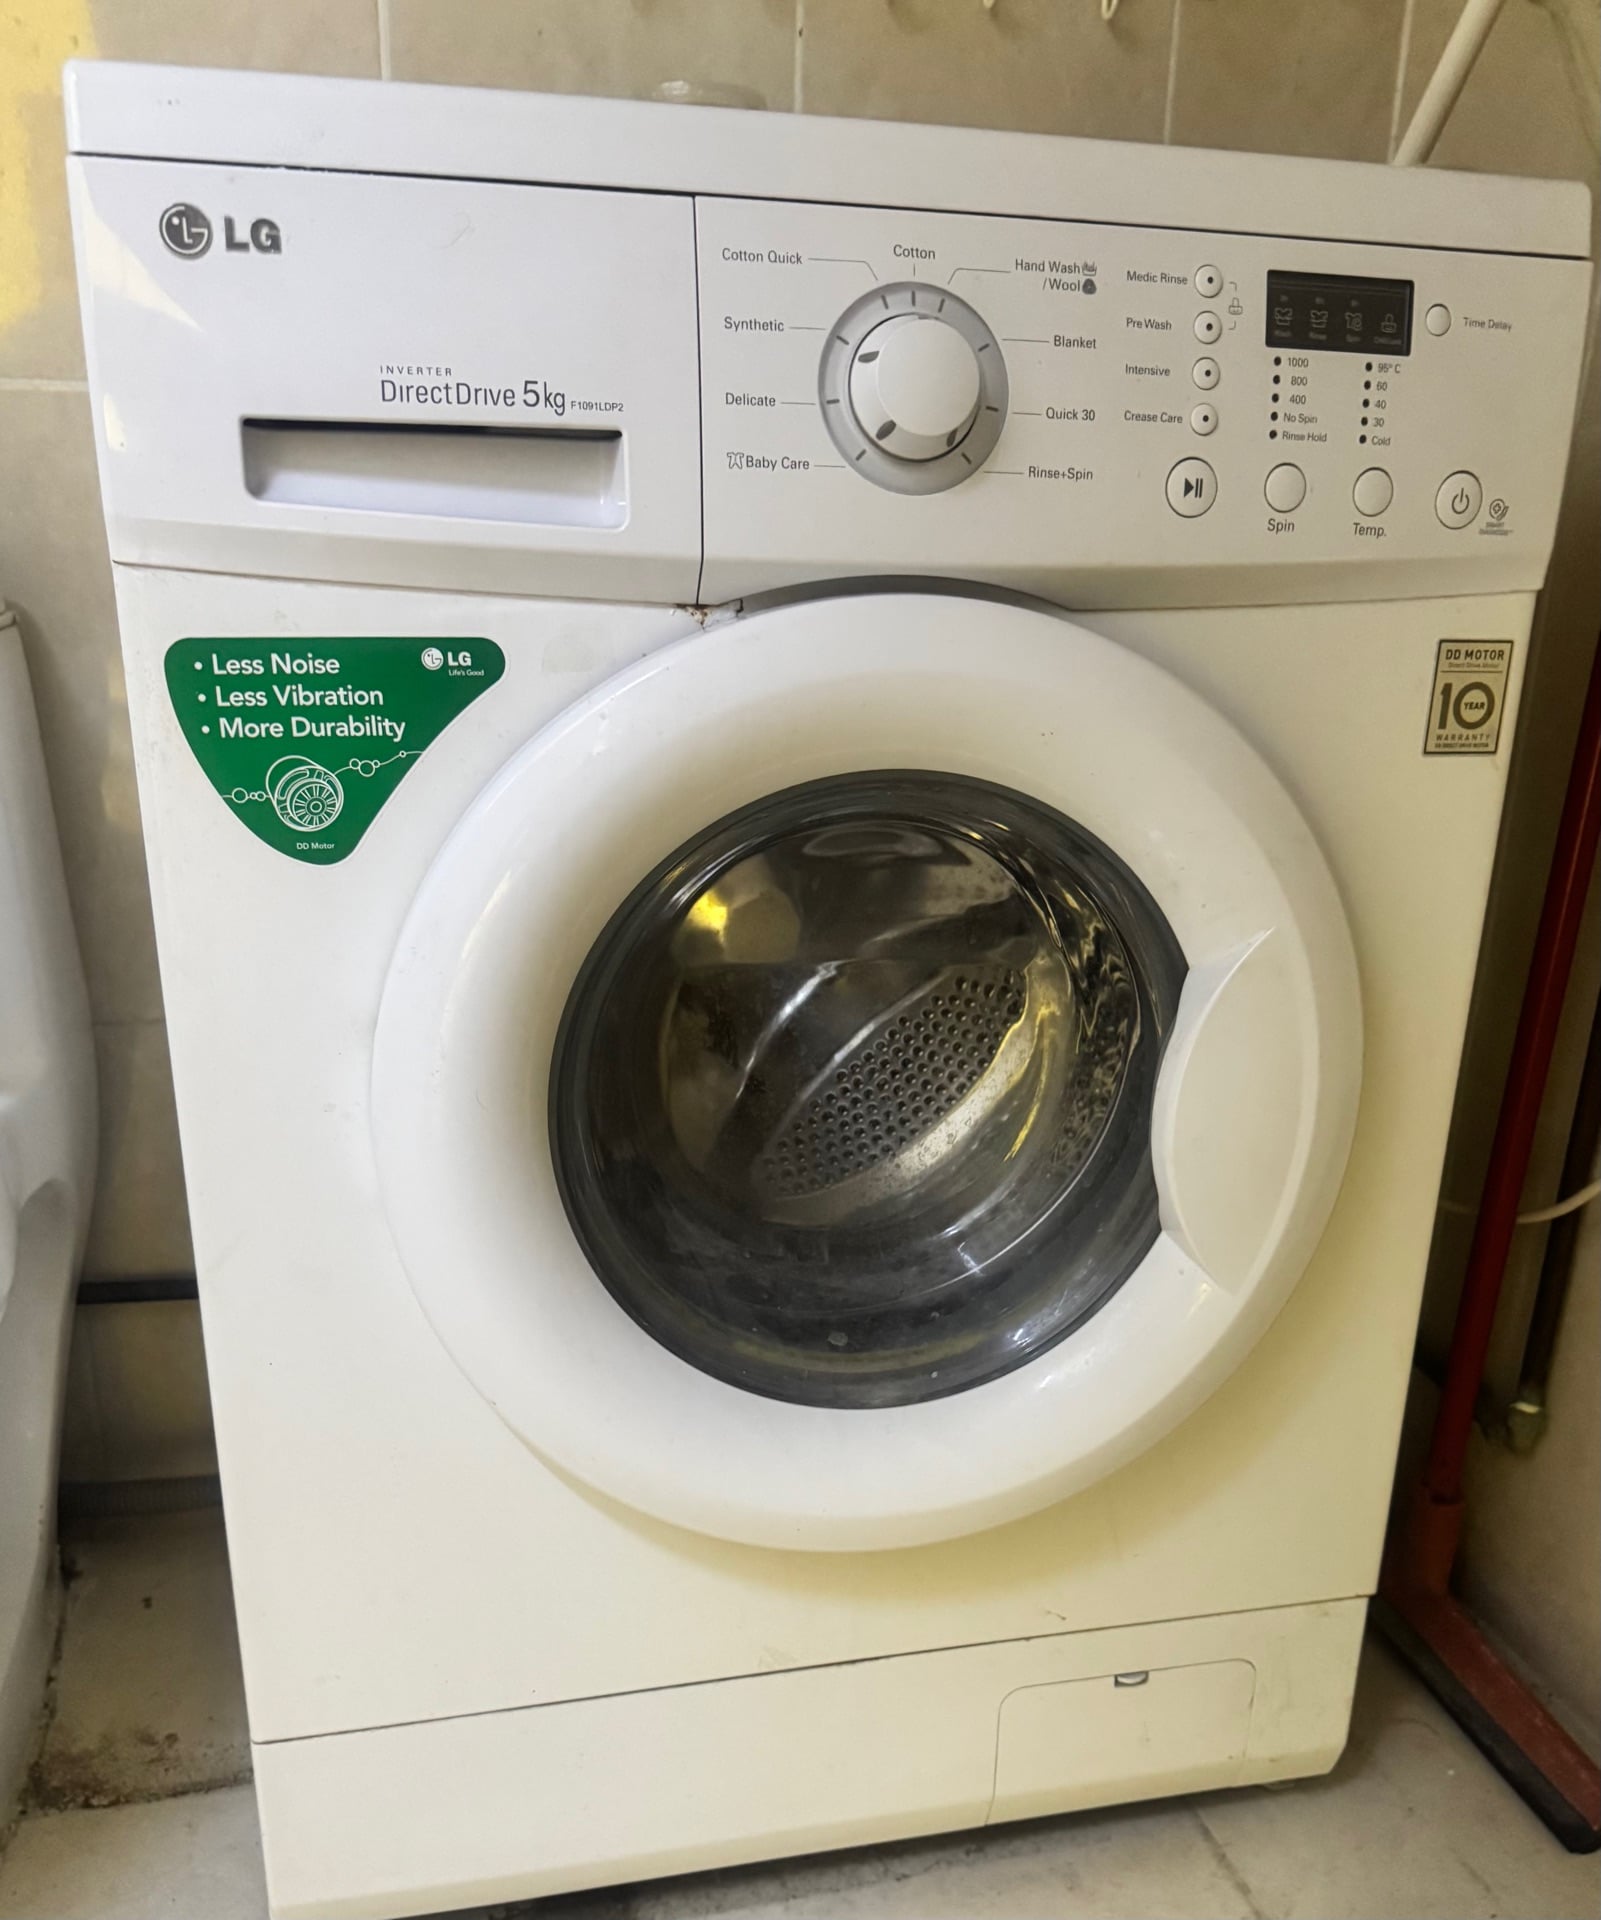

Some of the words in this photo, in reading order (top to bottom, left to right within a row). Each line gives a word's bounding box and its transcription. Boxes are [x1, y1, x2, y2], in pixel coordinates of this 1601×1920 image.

[224, 215, 282, 255] LG
[722, 248, 764, 263] Cotton
[768, 250, 803, 266] Quick
[893, 244, 936, 260] Cotton
[1015, 259, 1045, 273] Hand
[1049, 260, 1081, 275] Wash
[1043, 278, 1081, 292] /Wool
[1127, 271, 1157, 285] Medic
[1160, 273, 1188, 286] Rinse
[724, 317, 784, 334] Synthetic
[1126, 318, 1143, 330] Pre
[1144, 319, 1172, 331] Wash
[1463, 317, 1485, 329] Time
[1487, 319, 1512, 333] Delay
[1053, 335, 1097, 349] Blanket
[1287, 357, 1309, 368] 1000
[379, 365, 453, 376] INVERTER
[1125, 364, 1170, 377] Intensive
[1291, 375, 1308, 387] 800
[1376, 381, 1388, 391] 60
[522, 380, 566, 416] 5kg
[570, 399, 624, 413] F1091LDP2
[725, 393, 776, 408] Delicate
[1290, 393, 1306, 405] 400
[1374, 399, 1387, 410] 40
[1046, 408, 1078, 422] Quick
[1081, 409, 1096, 421] 30
[1124, 411, 1157, 423] Crease
[1160, 414, 1183, 425] Care
[1284, 412, 1296, 423] No
[1298, 413, 1318, 425] Spin
[1373, 417, 1384, 427] 30
[1282, 430, 1305, 442] Rinse
[1307, 431, 1327, 443] Hold
[1371, 435, 1391, 446] Cold
[746, 456, 777, 471] Baby
[781, 457, 809, 470] Care
[1028, 466, 1093, 482] Rinse+Spin
[1267, 519, 1295, 533] Spin
[1353, 523, 1387, 538] Temp.
[448, 652, 472, 666] LG
[1446, 649, 1461, 660] DD
[1464, 650, 1504, 660] MOTOR
[212, 653, 264, 675] Less
[271, 653, 340, 675] Noise
[215, 686, 267, 707] Less
[272, 685, 383, 706] Vibration
[1438, 682, 1495, 729] 10
[1464, 702, 1485, 710] YEAR
[219, 717, 284, 738] More
[291, 715, 405, 742] Durability
[297, 842, 309, 850] DD
[311, 842, 335, 850] Motor
